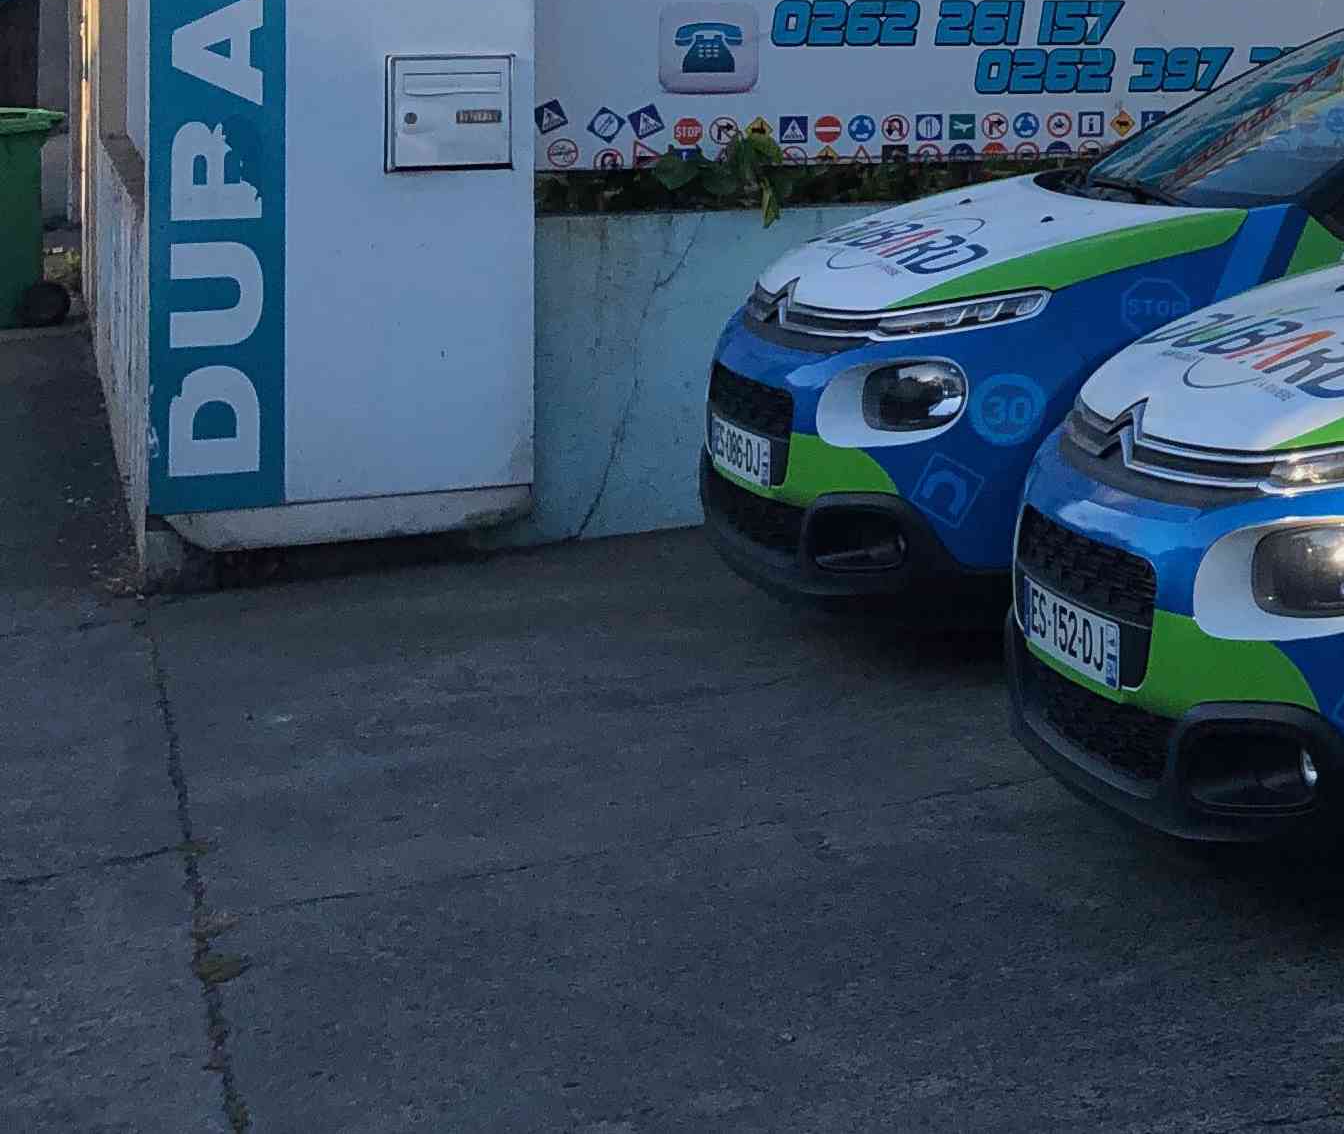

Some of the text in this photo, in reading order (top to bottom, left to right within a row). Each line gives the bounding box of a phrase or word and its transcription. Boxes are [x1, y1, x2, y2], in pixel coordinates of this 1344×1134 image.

[770, 0, 1126, 46] 0262 261 157
[974, 47, 1115, 95] 0262
[1127, 46, 1235, 93] 397
[985, 396, 1031, 423] 30
[1031, 587, 1105, 672] ES-152-DJ
